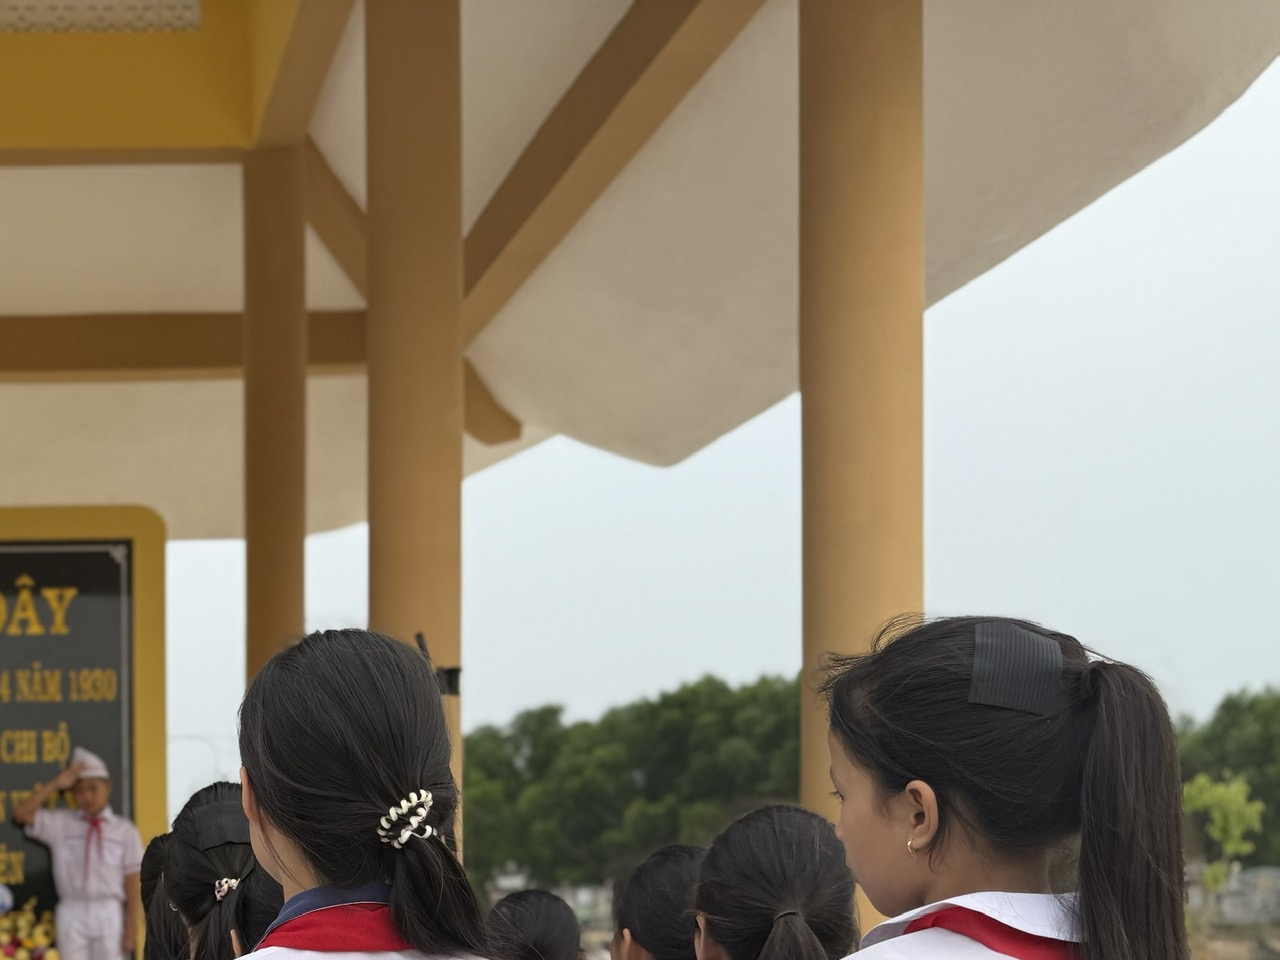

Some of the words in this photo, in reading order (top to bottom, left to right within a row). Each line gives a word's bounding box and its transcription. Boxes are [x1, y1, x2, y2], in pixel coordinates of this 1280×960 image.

[16, 661, 62, 703] NĂM
[0, 730, 38, 764] CHI
[41, 720, 71, 769] BỘ
